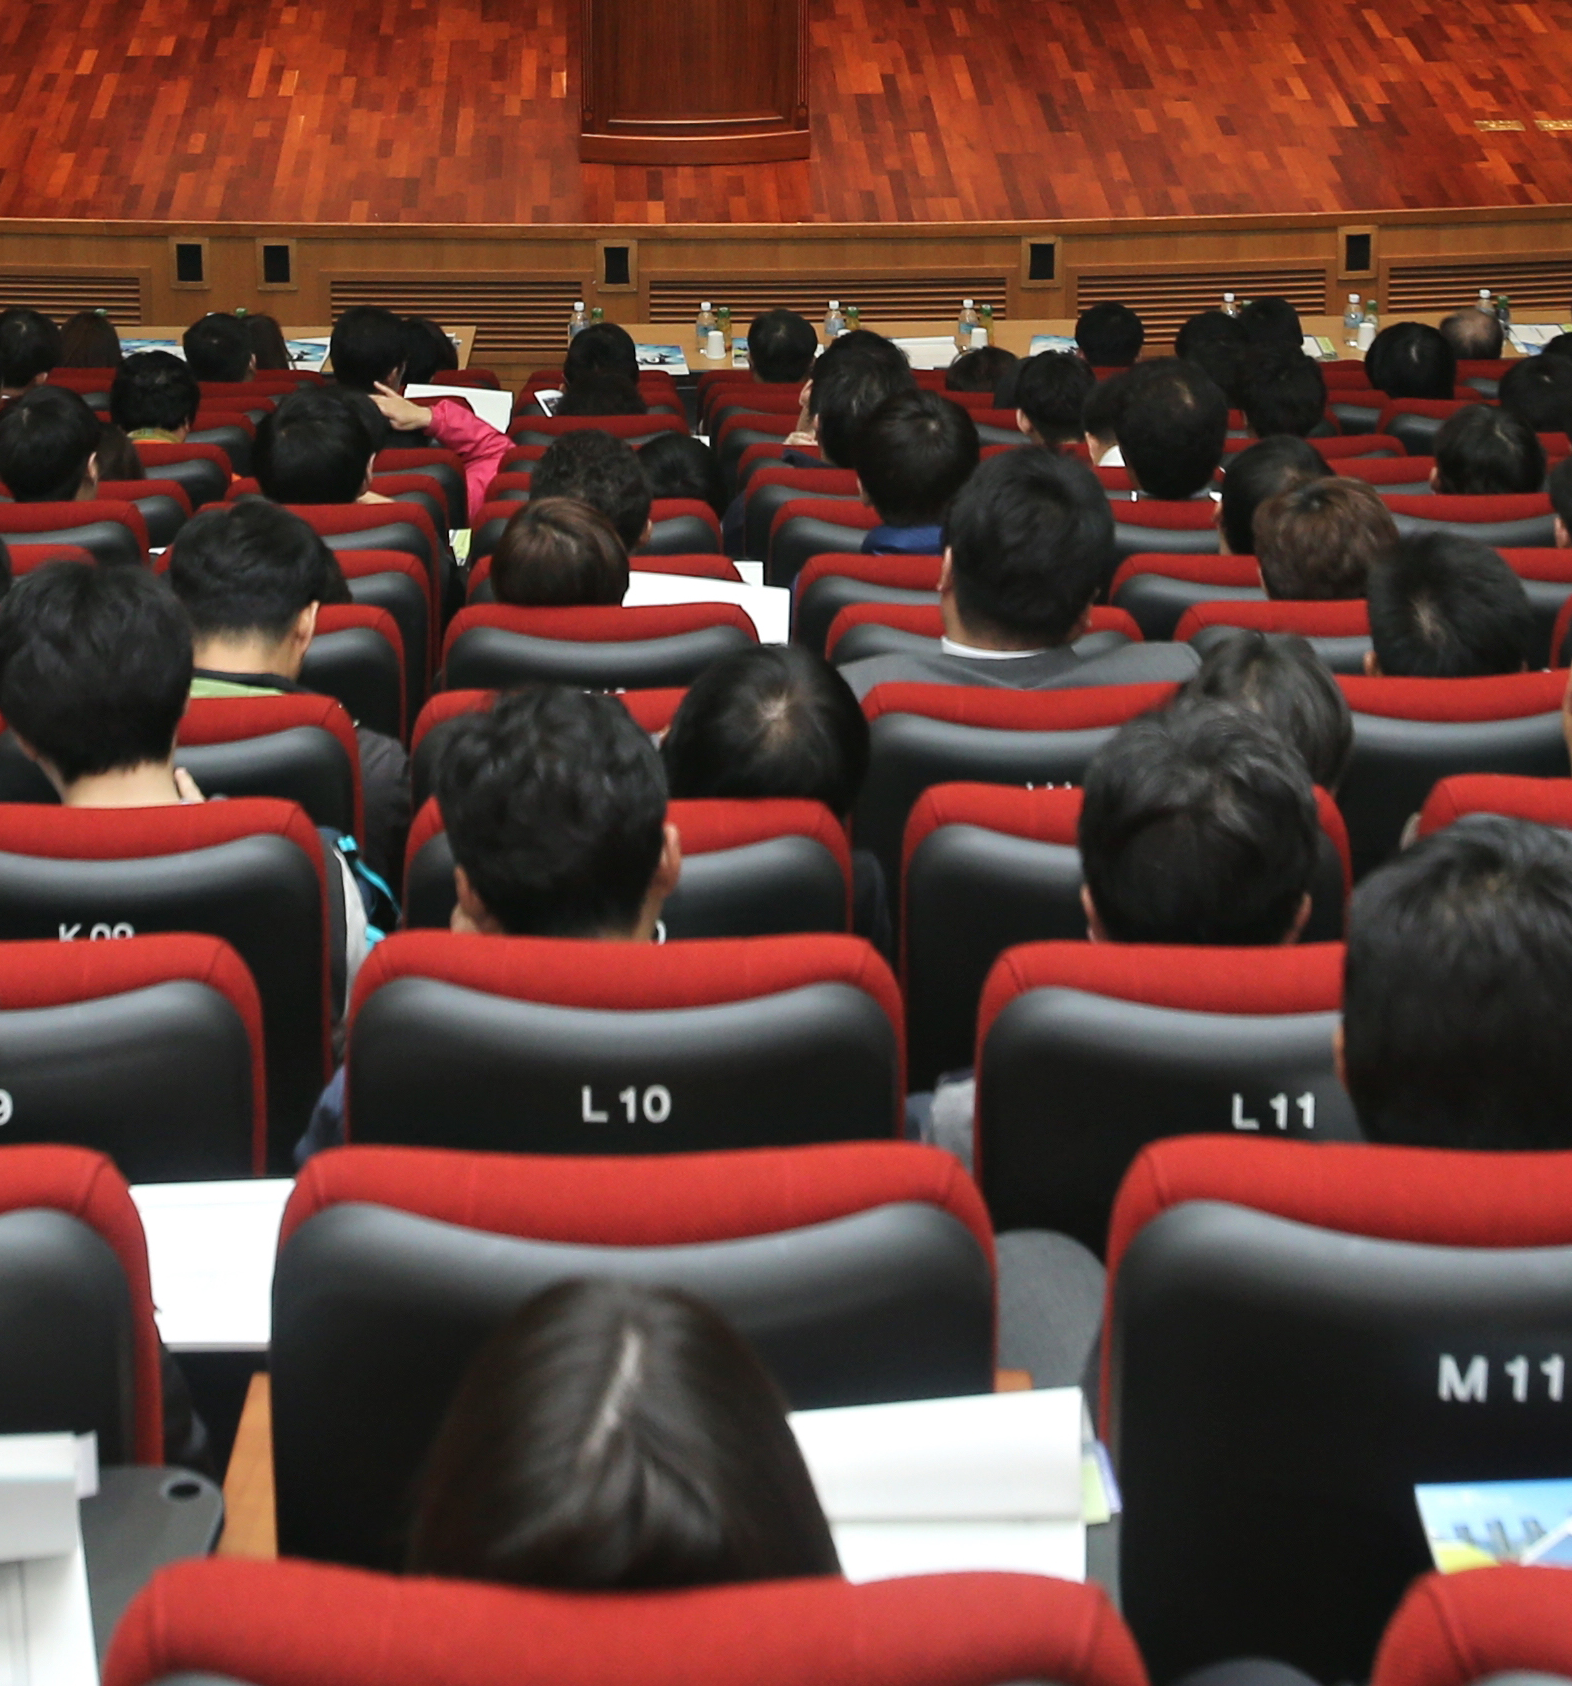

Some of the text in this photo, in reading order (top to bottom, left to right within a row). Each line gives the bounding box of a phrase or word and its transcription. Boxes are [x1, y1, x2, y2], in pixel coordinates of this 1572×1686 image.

[581, 1084, 672, 1123] L 10
[1231, 1091, 1316, 1130] L 11
[1437, 1354, 1566, 1403] M 11
